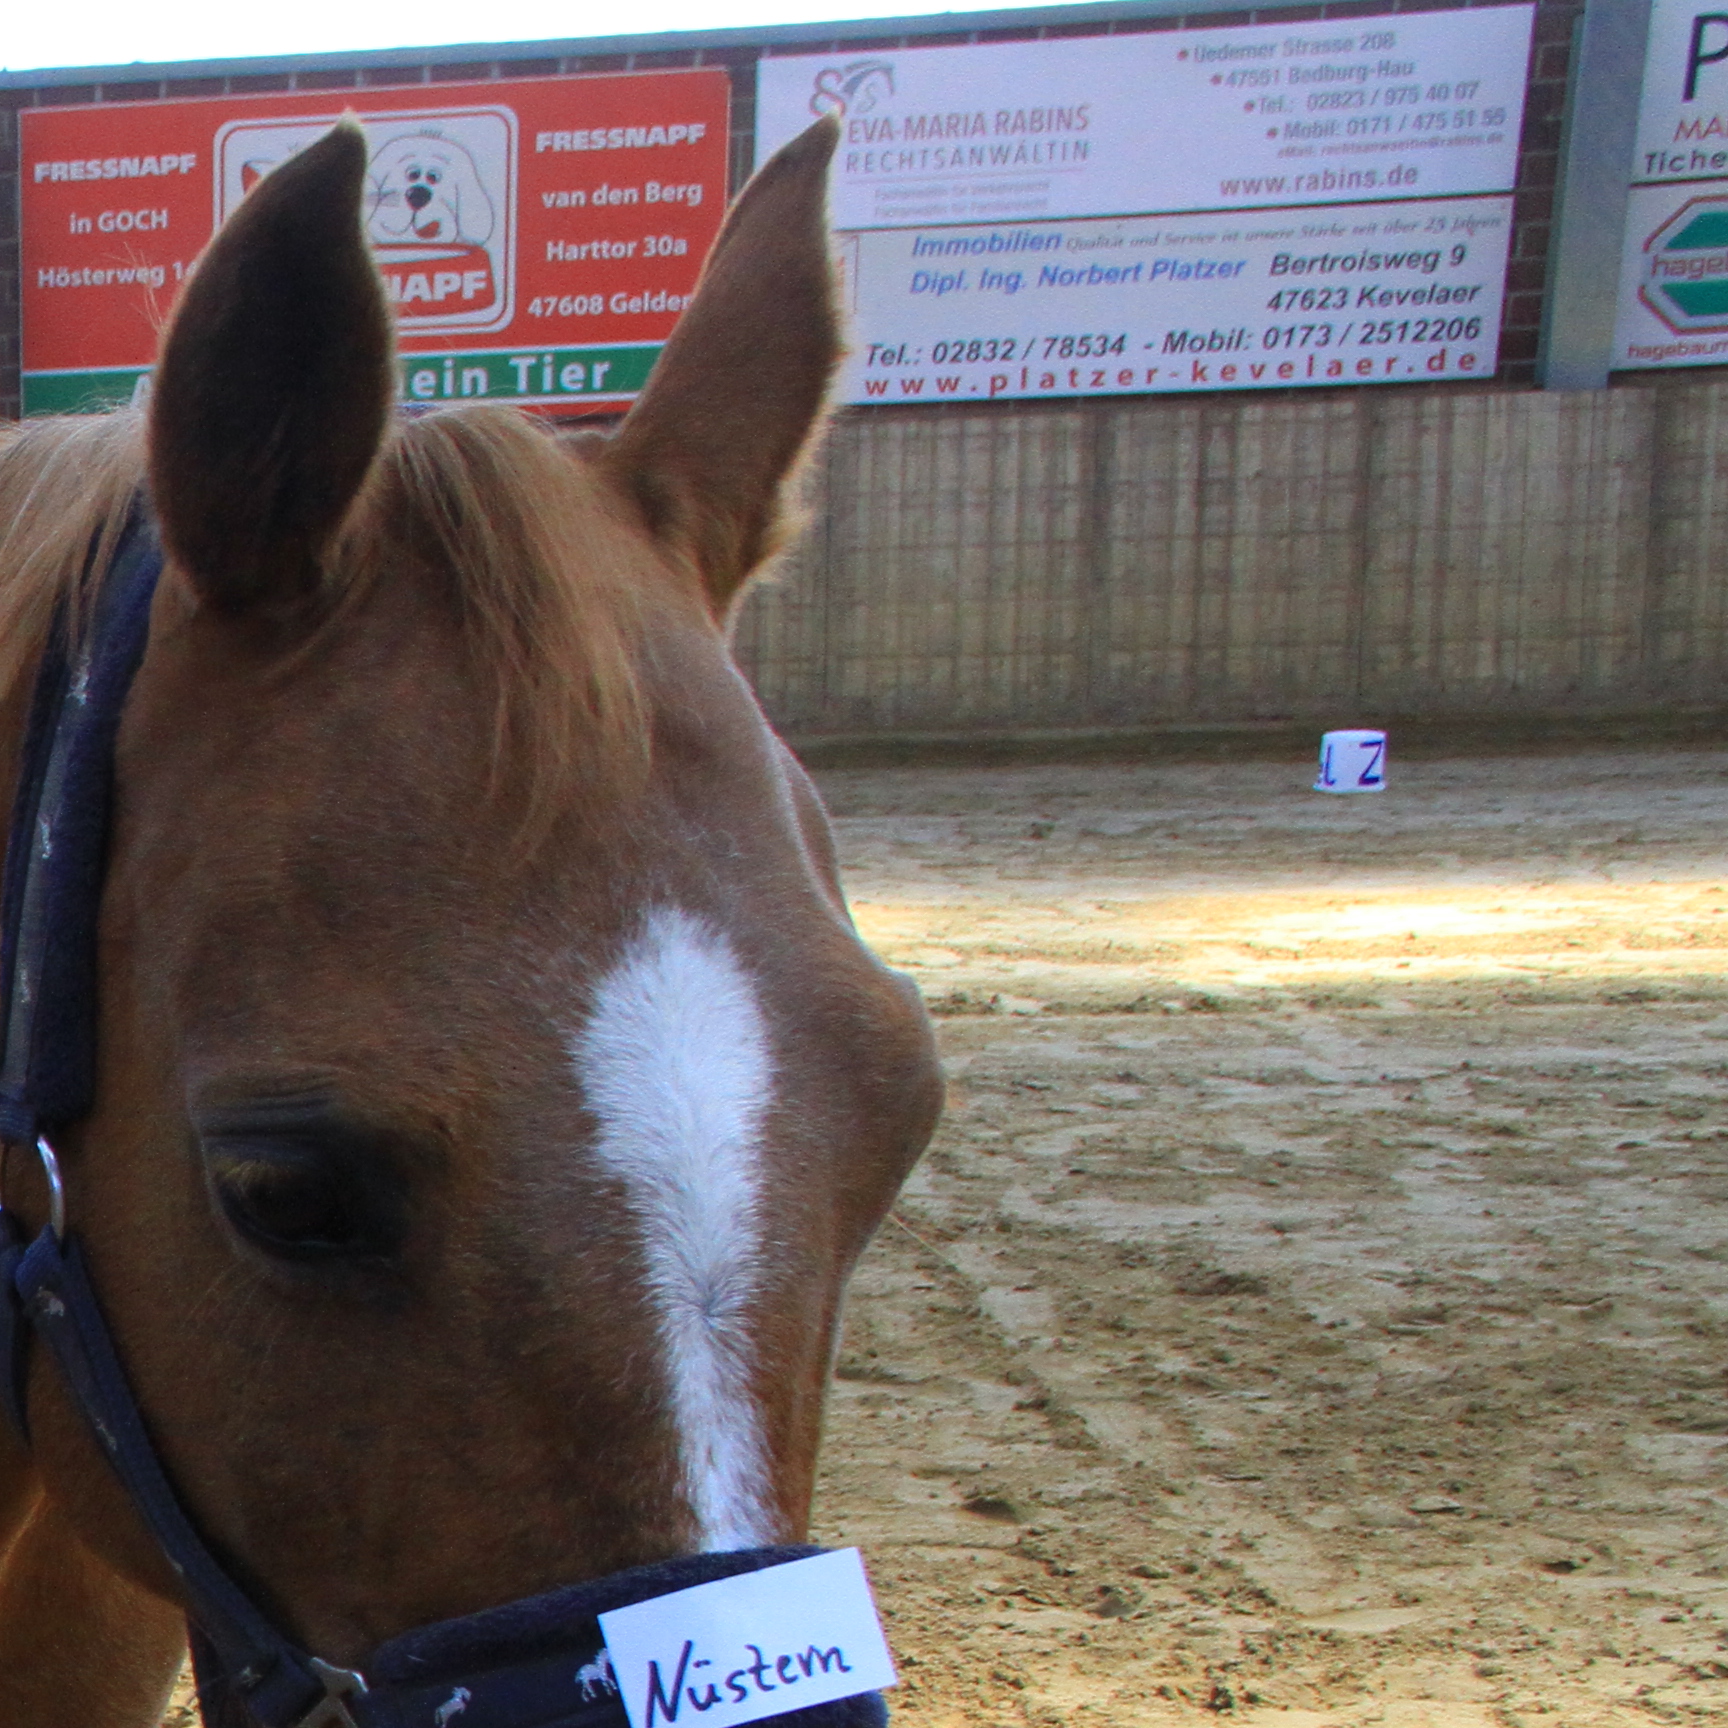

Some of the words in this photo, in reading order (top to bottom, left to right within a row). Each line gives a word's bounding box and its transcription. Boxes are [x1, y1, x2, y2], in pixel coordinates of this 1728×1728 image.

[536, 124, 707, 153] FRESSNAPF
[847, 112, 987, 144] EVA-MARIA
[995, 104, 1091, 135] RABINS
[1674, 116, 1728, 142] MA
[34, 153, 197, 183] FRESSNAPF
[1219, 164, 1419, 196] www.rabins.de
[542, 191, 586, 208] van
[592, 183, 639, 206] den
[645, 181, 703, 207] Berg
[69, 211, 92, 234] in
[98, 208, 169, 233] GOCH
[546, 239, 638, 262] Harttor
[643, 235, 688, 257] 30a
[913, 229, 1063, 257] Immobilien
[1269, 248, 1442, 278] Bertroisweg
[1450, 244, 1467, 266] 9
[38, 265, 165, 290] Hösterweg
[910, 268, 968, 296] Dipl.
[978, 266, 1027, 294] Ing.
[1038, 261, 1145, 288] Norbert
[1149, 257, 1247, 281] Platzer
[528, 294, 604, 318] 47608
[1267, 288, 1350, 313] 47623
[1355, 282, 1483, 309] Kevelaer
[932, 338, 1016, 364] 02832
[1043, 332, 1128, 360] 78534
[1162, 328, 1252, 355] Mobil:
[1262, 323, 1333, 349] 0173
[1358, 315, 1483, 345] 2512206
[508, 356, 611, 393] Tier
